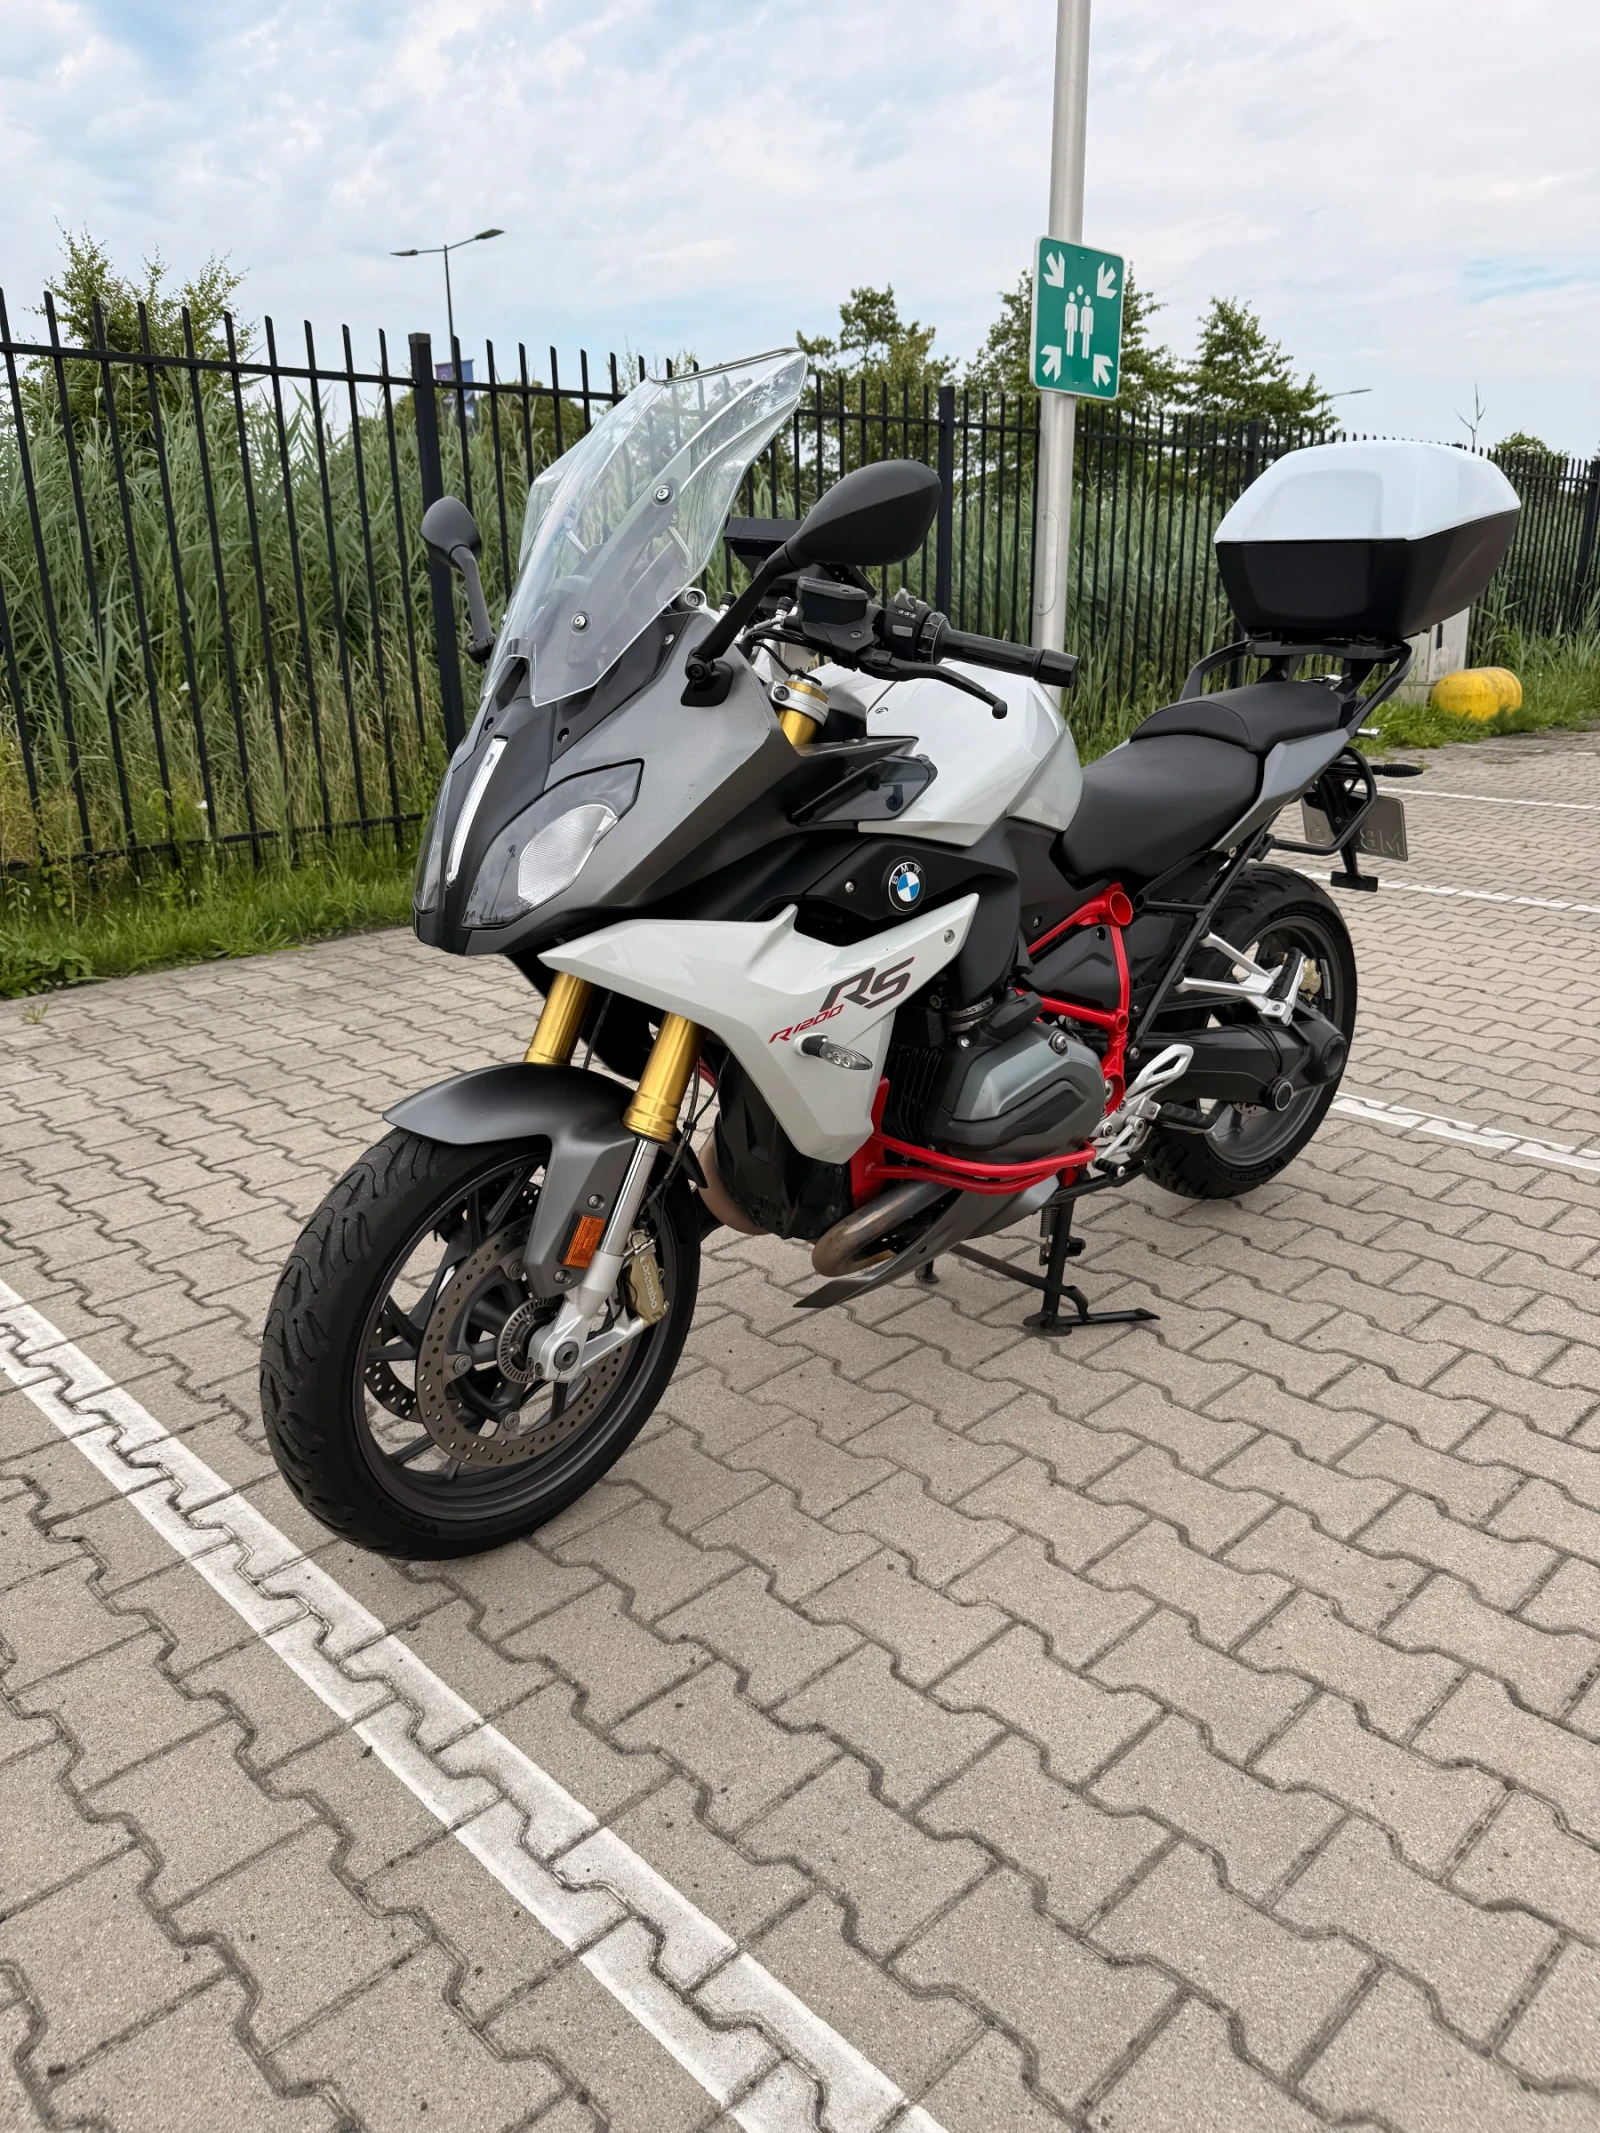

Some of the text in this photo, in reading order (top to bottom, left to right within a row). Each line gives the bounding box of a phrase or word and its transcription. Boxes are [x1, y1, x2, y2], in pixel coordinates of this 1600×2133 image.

[890, 863, 922, 885] BMW
[819, 956, 915, 1012] RS
[768, 1004, 844, 1043] R1200
[642, 1262, 658, 1309] brembo
